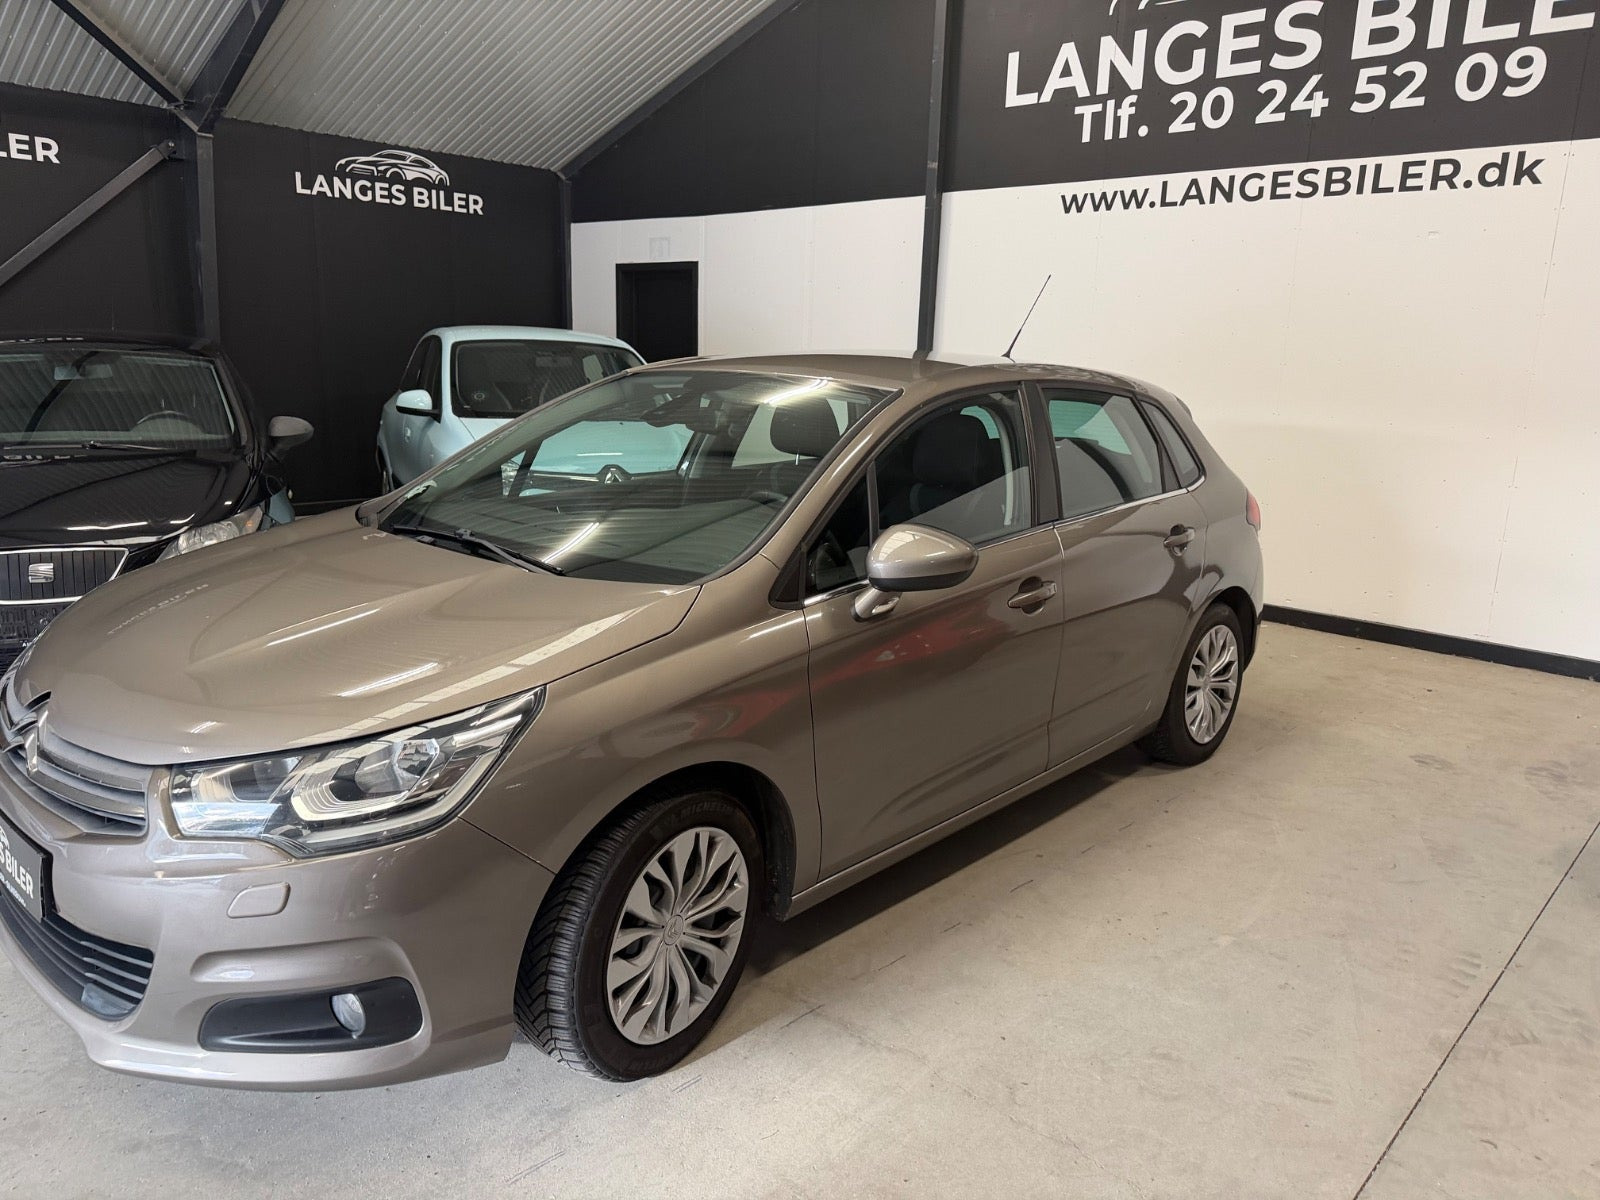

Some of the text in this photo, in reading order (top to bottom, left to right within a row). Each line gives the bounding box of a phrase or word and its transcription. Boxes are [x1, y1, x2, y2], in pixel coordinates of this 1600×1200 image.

[1005, 0, 1324, 108] LANGES
[1074, 46, 1547, 143] Tlf. 20 24 52 09
[295, 171, 484, 216] LANGES BILER
[1060, 151, 1546, 214] www.LANGESBILER.dk
[5, 849, 34, 899] BILER
